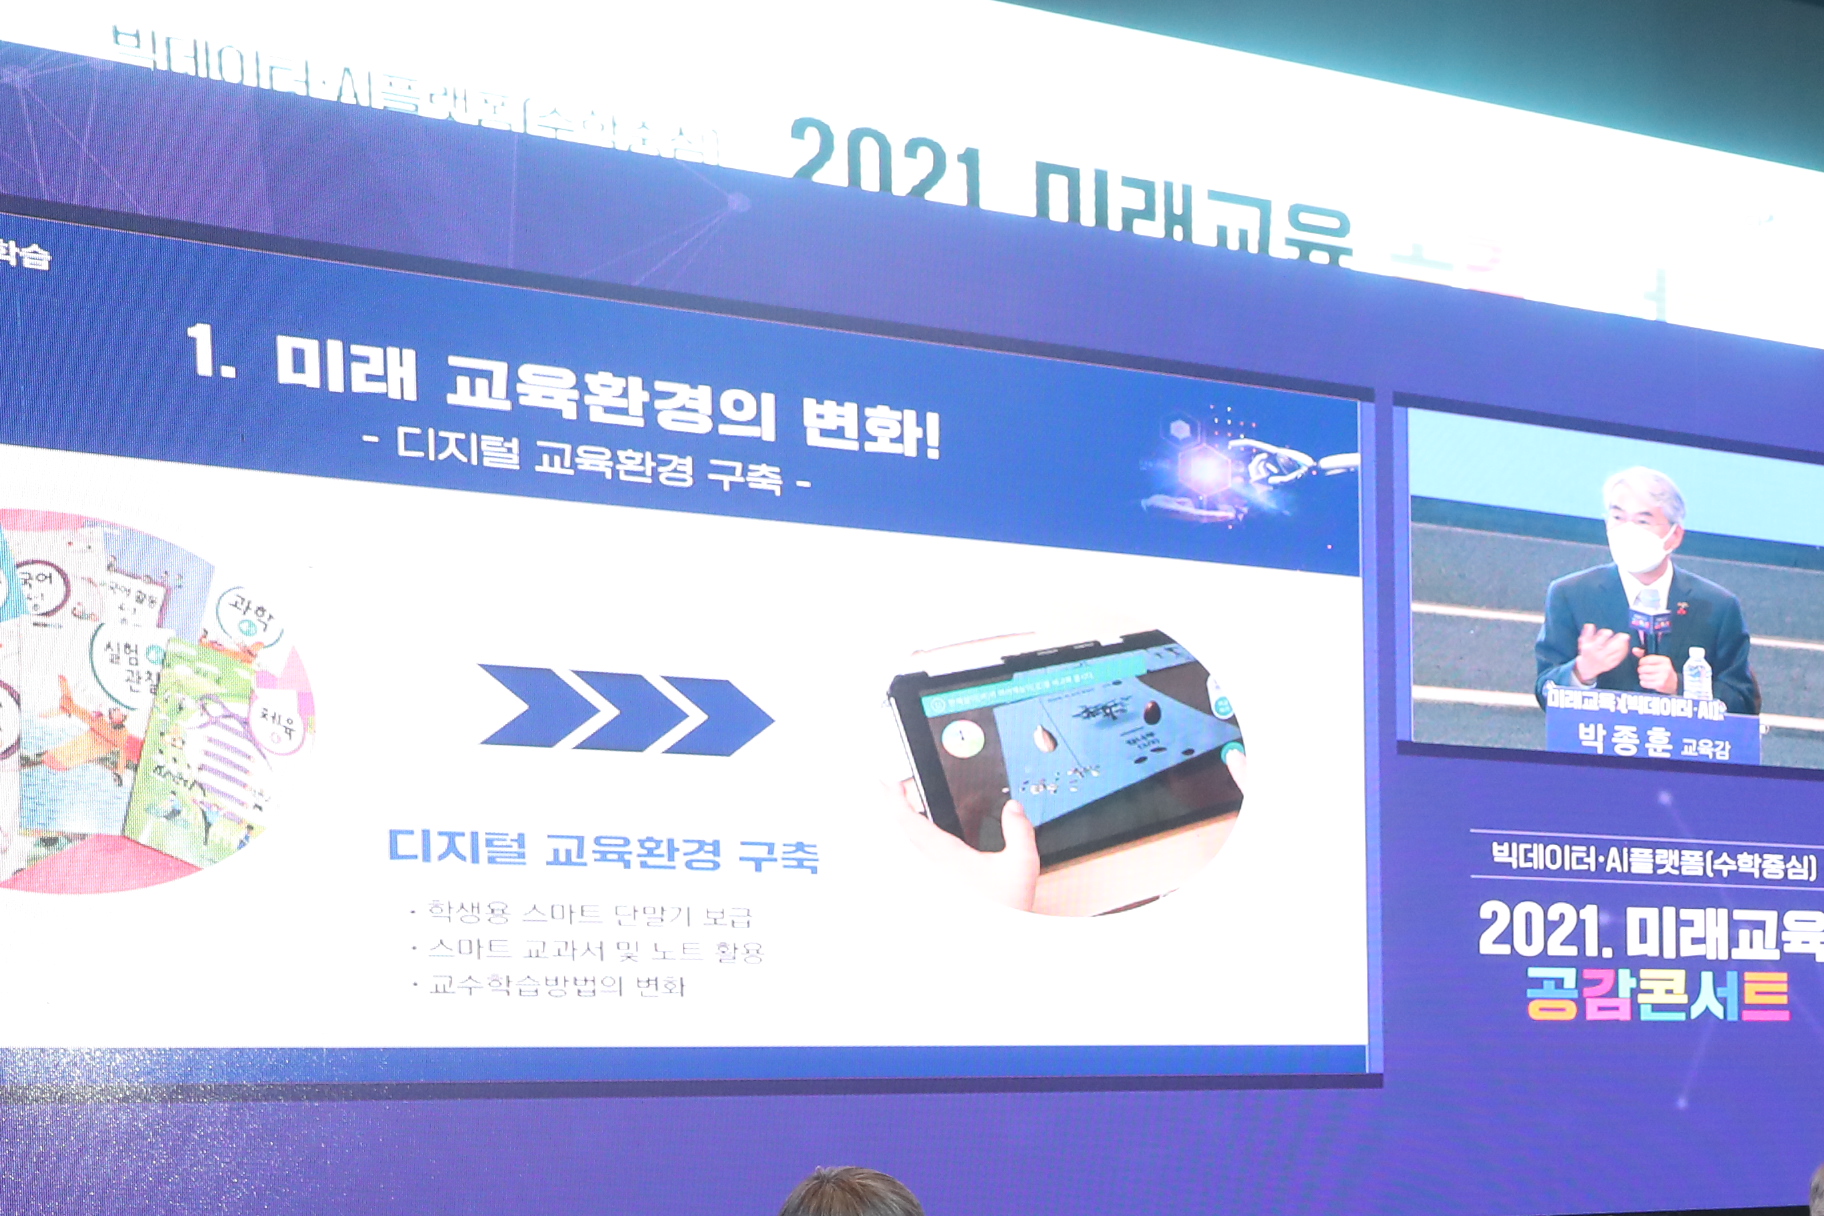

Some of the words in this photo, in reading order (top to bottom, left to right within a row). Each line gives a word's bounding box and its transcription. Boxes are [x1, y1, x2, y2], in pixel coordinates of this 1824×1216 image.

[790, 117, 981, 208] 2021
[1036, 160, 1353, 268] 미래교육
[187, 323, 236, 378] 1.
[276, 334, 418, 402] 미래
[446, 355, 776, 442] 교육환경의
[803, 397, 940, 460] 변화!
[398, 426, 520, 470] 디지털
[535, 440, 694, 488] 교육환경
[707, 458, 783, 496] 구축
[1681, 738, 1732, 760] 교육감
[388, 828, 527, 865] 디지털
[545, 834, 722, 871] 교육환경
[739, 840, 819, 875] 구축
[428, 900, 511, 925] 학생용
[522, 903, 604, 925] 스마트
[614, 905, 691, 927] 단말기
[703, 907, 754, 929] 보급
[1478, 899, 1613, 959] 2021.
[428, 938, 513, 960] 스마트
[523, 940, 604, 962] 교과서
[616, 941, 639, 963] 및
[652, 942, 705, 961] 노트
[714, 941, 765, 965] 활용
[429, 974, 622, 998] 교수학습방법의
[636, 976, 687, 998] 변화
[1526, 966, 1791, 1021] 공감콘서트
